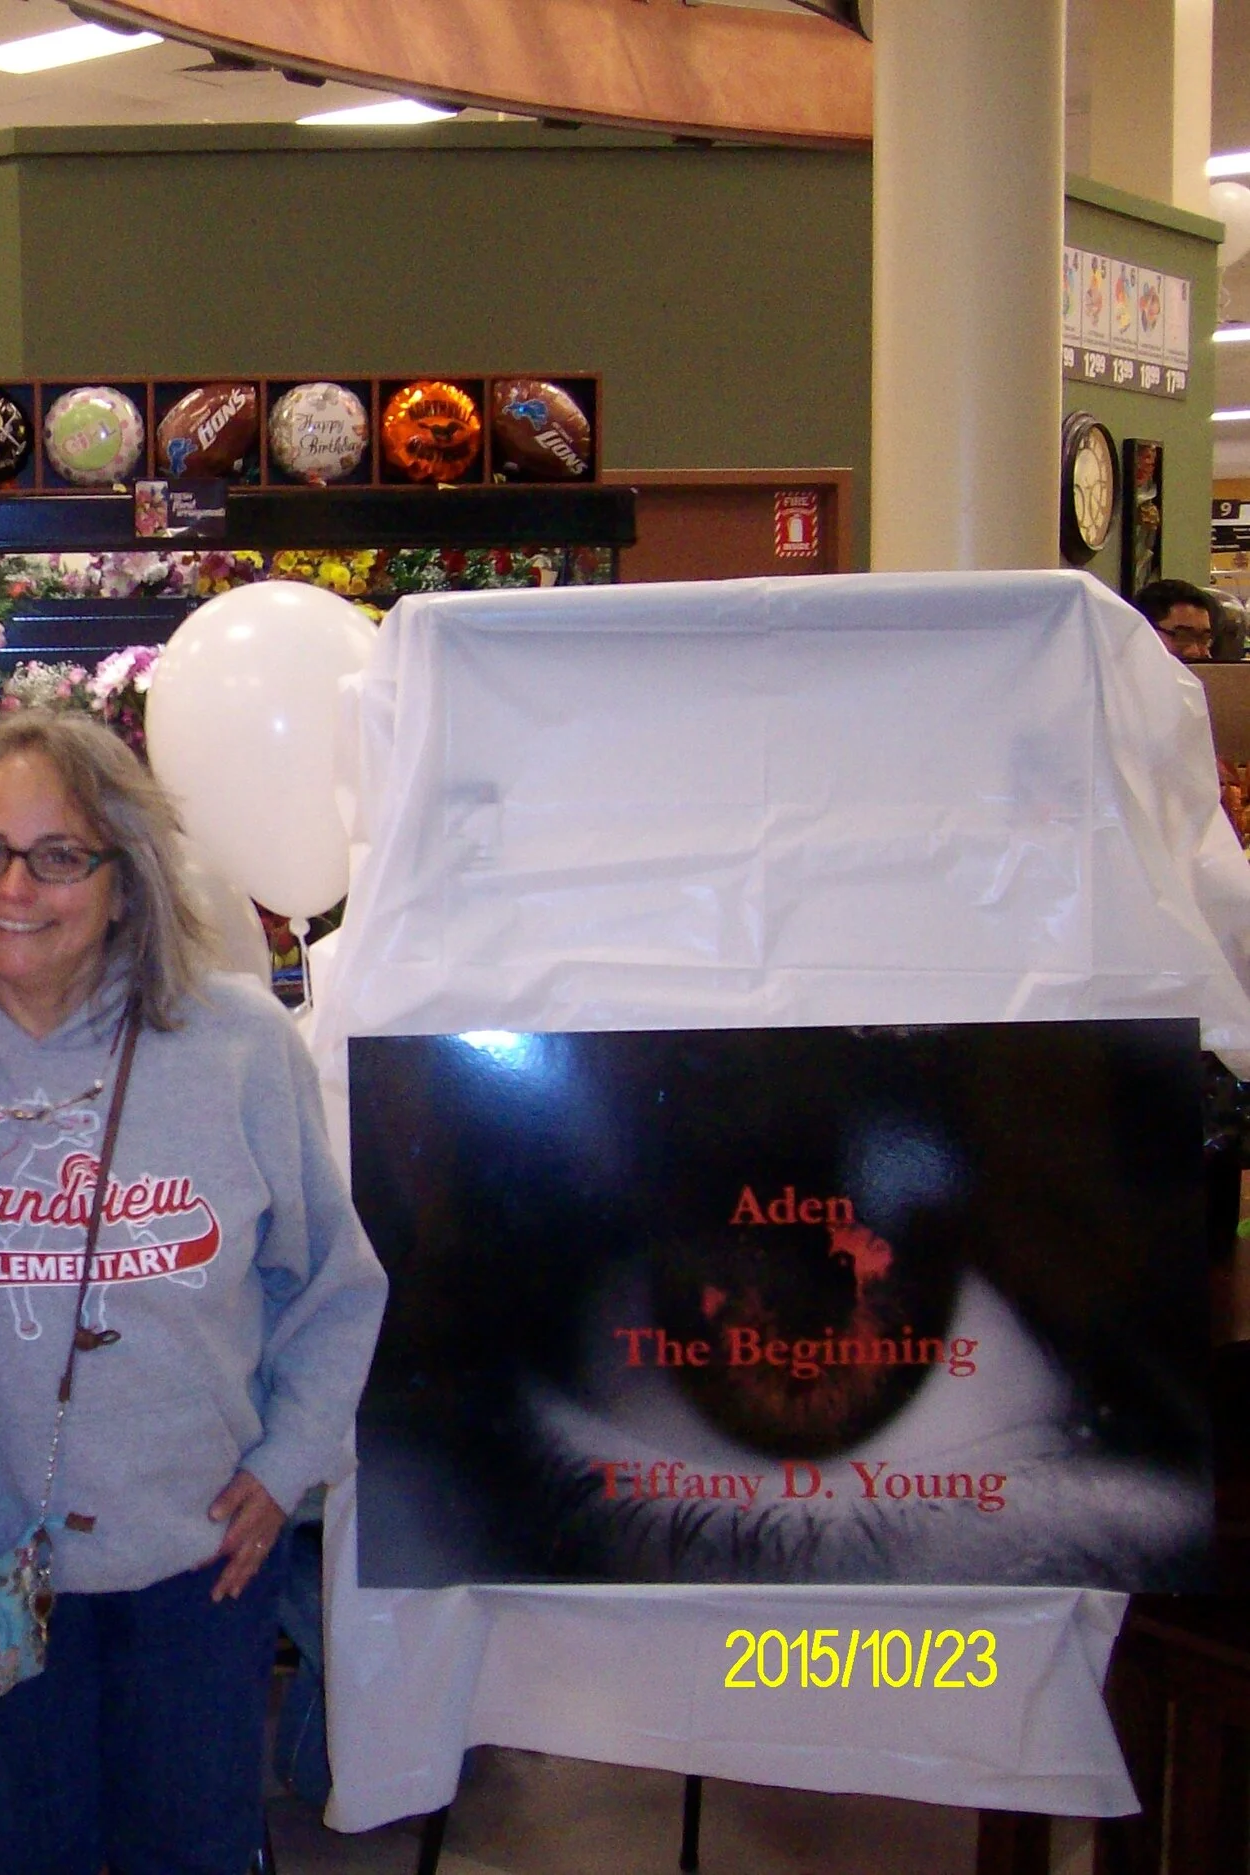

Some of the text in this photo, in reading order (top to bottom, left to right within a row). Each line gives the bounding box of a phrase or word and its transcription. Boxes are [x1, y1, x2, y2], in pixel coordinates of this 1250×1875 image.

[197, 387, 246, 451] LIONS
[292, 411, 346, 435] Happy
[533, 429, 589, 475] LIONS
[1220, 502, 1232, 517] 9
[729, 1184, 855, 1225] Aden
[614, 1325, 979, 1379] The Beginning
[591, 1459, 1008, 1513] Tiffany D. Young
